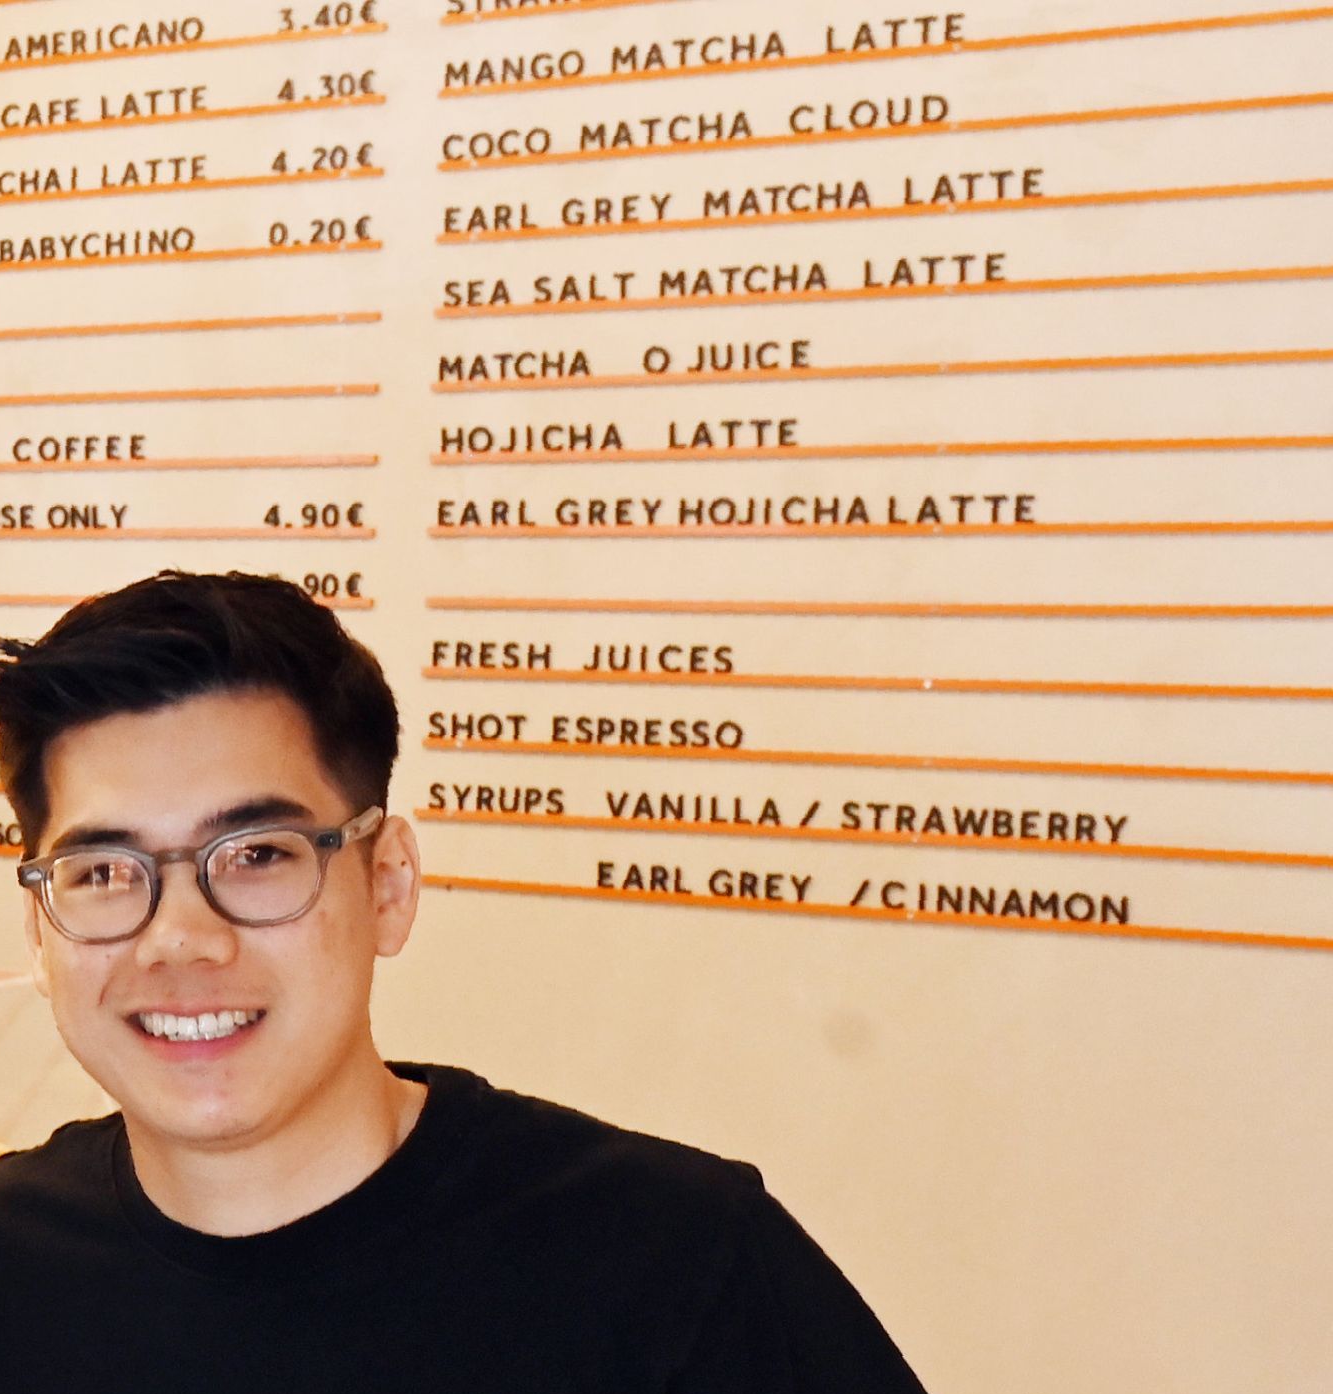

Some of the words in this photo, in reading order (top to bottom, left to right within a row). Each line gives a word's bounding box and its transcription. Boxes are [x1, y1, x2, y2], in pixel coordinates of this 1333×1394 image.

[5, 17, 204, 61] AMERICANO
[445, 50, 585, 87] MANGO
[611, 32, 785, 73] MATCHA
[826, 13, 964, 53] LATTE
[277, 70, 374, 101] 4.30€
[0, 98, 78, 127] CAFE
[101, 86, 206, 120] LATTE
[442, 128, 551, 161] COCO
[579, 111, 752, 150] MATCHA
[789, 95, 949, 133] CLOUD
[101, 156, 204, 187] LATTE
[444, 204, 533, 233] EARL
[561, 194, 671, 225] GREY
[703, 181, 871, 217] MATCHA
[904, 168, 1043, 205] LATTE
[0, 227, 195, 263] BABYCHINO
[444, 279, 510, 307] SEA
[534, 272, 635, 302] SALT
[659, 262, 827, 297] MATCHA
[864, 253, 1005, 288] LATTE
[438, 350, 590, 382] MATCHA
[642, 345, 671, 374] O
[694, 340, 810, 372] JUICE
[12, 434, 145, 462] COFFEE
[441, 423, 623, 454] HOJICHA
[669, 418, 797, 449] LATTE
[47, 504, 128, 529] ONLY
[437, 500, 536, 527] EARL
[555, 498, 662, 526] GREY
[678, 496, 870, 525] HOJICHA
[887, 494, 1036, 524] LATTE
[432, 640, 552, 670] FRESH
[583, 644, 733, 674] JUICES
[428, 711, 527, 741] SHOT
[551, 715, 744, 749] ESPRESSO
[428, 782, 565, 815] SYRUPS
[606, 791, 781, 827] VANILLA
[799, 801, 821, 827] /
[840, 801, 1128, 844] STRAWBERRY
[596, 860, 692, 895] EARL
[708, 868, 812, 903] GREY
